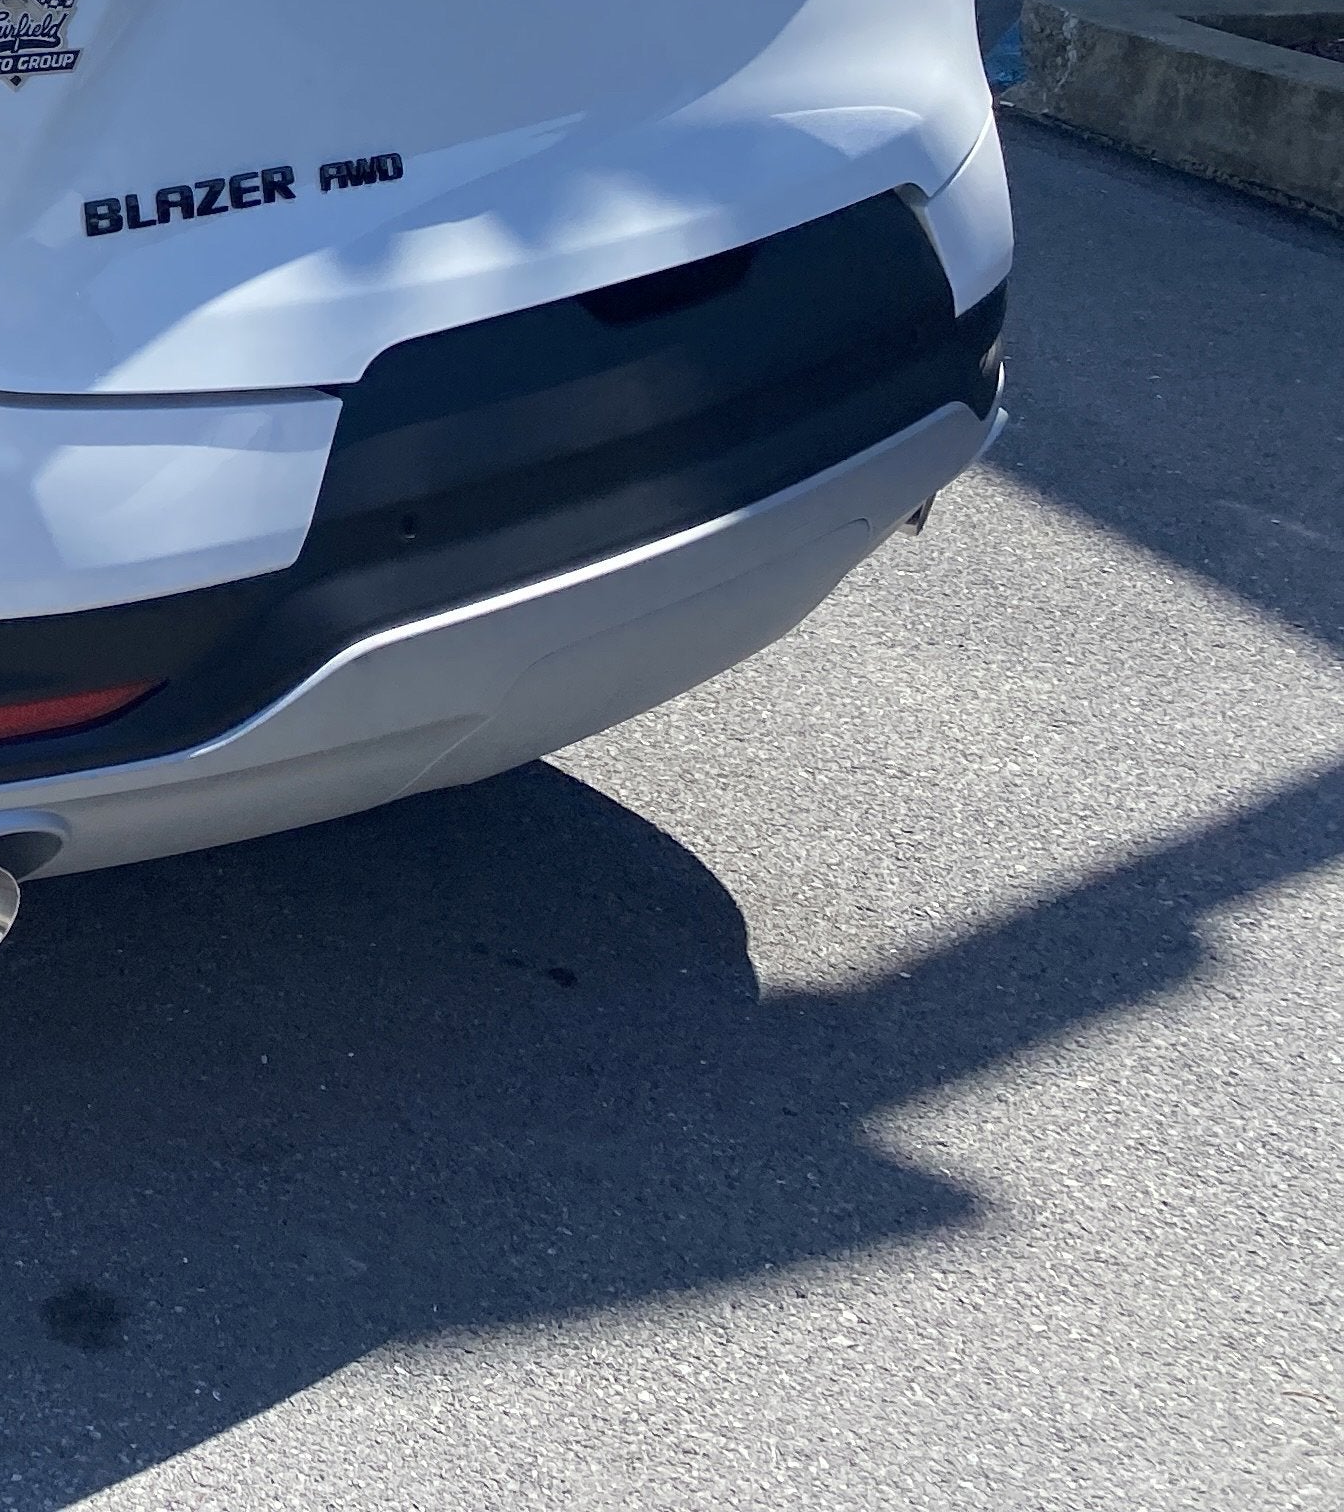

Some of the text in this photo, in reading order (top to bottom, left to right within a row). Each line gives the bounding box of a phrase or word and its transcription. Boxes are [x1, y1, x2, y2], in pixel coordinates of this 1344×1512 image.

[18, 53, 74, 70] GROUP
[83, 152, 404, 237] BLAZER AWD
